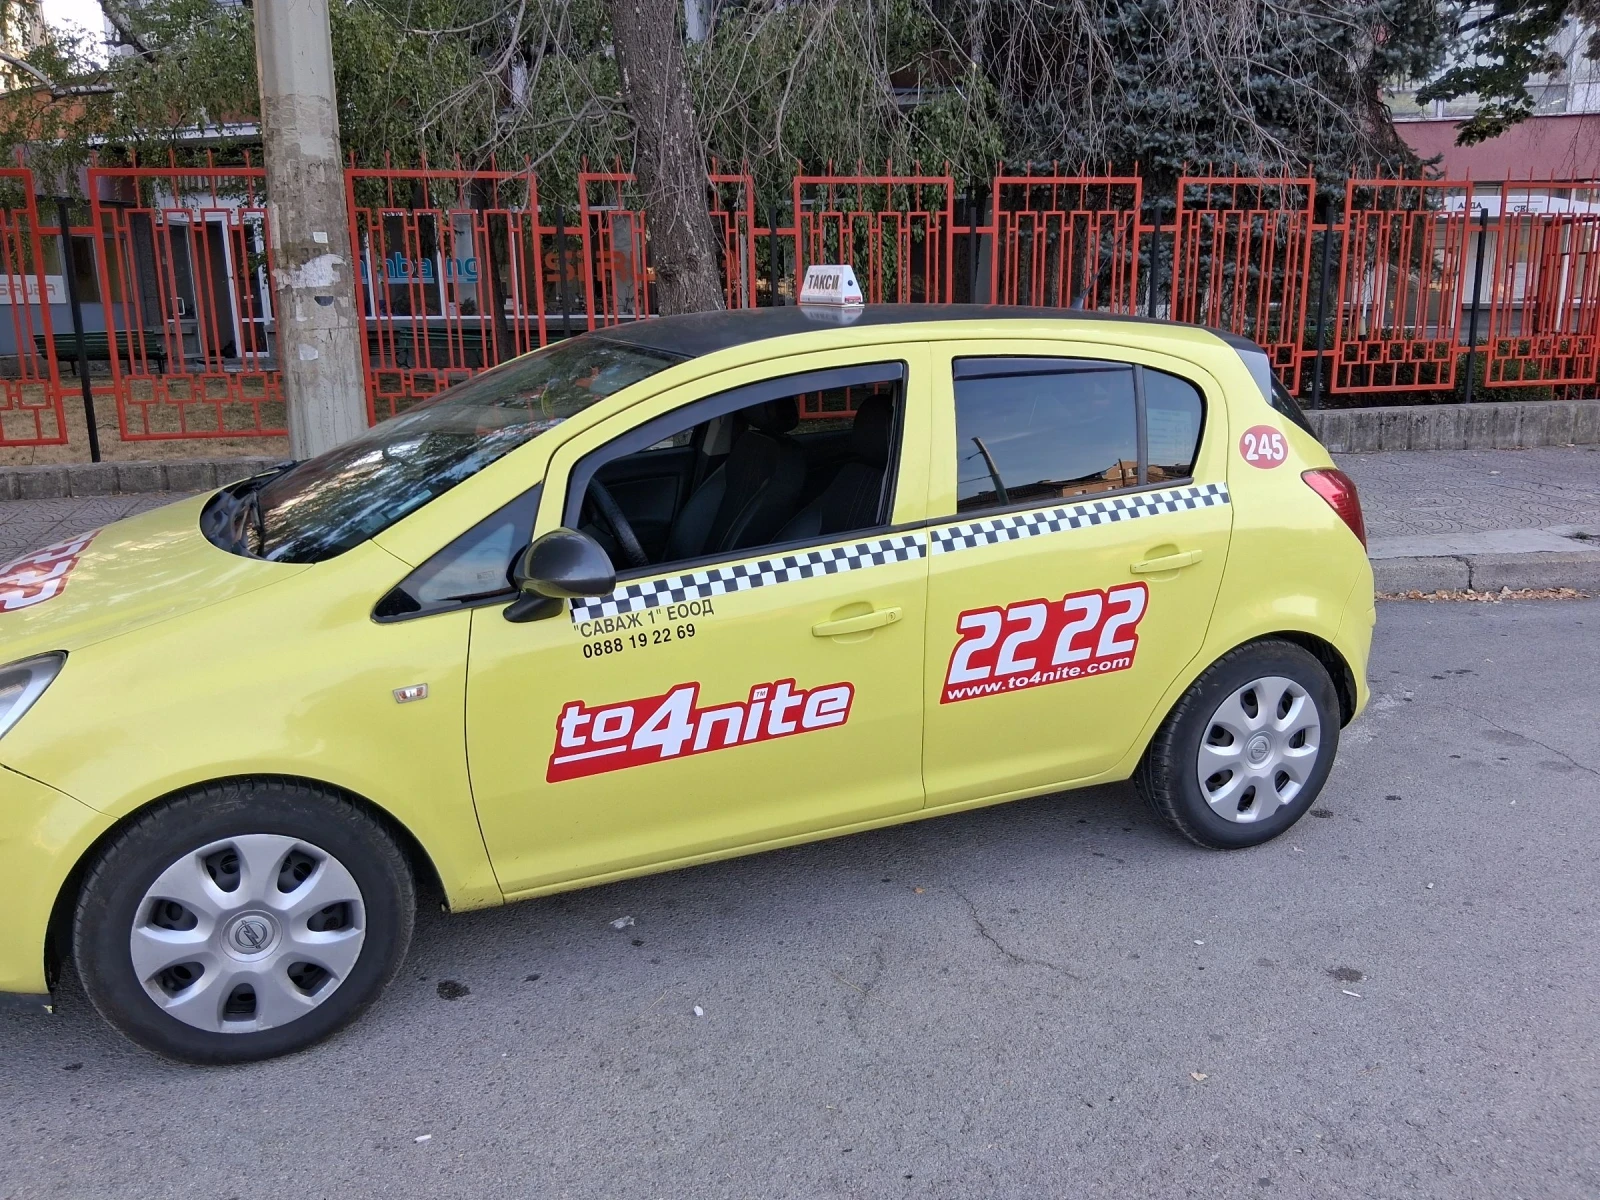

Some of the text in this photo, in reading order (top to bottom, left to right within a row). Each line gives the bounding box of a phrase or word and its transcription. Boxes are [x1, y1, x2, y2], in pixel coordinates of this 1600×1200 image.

[808, 274, 840, 290] ТАКСИ
[1244, 433, 1284, 460] 245
[573, 599, 715, 638] "САВАЖ 1" ЕООД
[583, 623, 696, 659] 0888 19 22 69
[947, 656, 1131, 700] www.to4nite.com
[560, 683, 851, 758] to4nite
